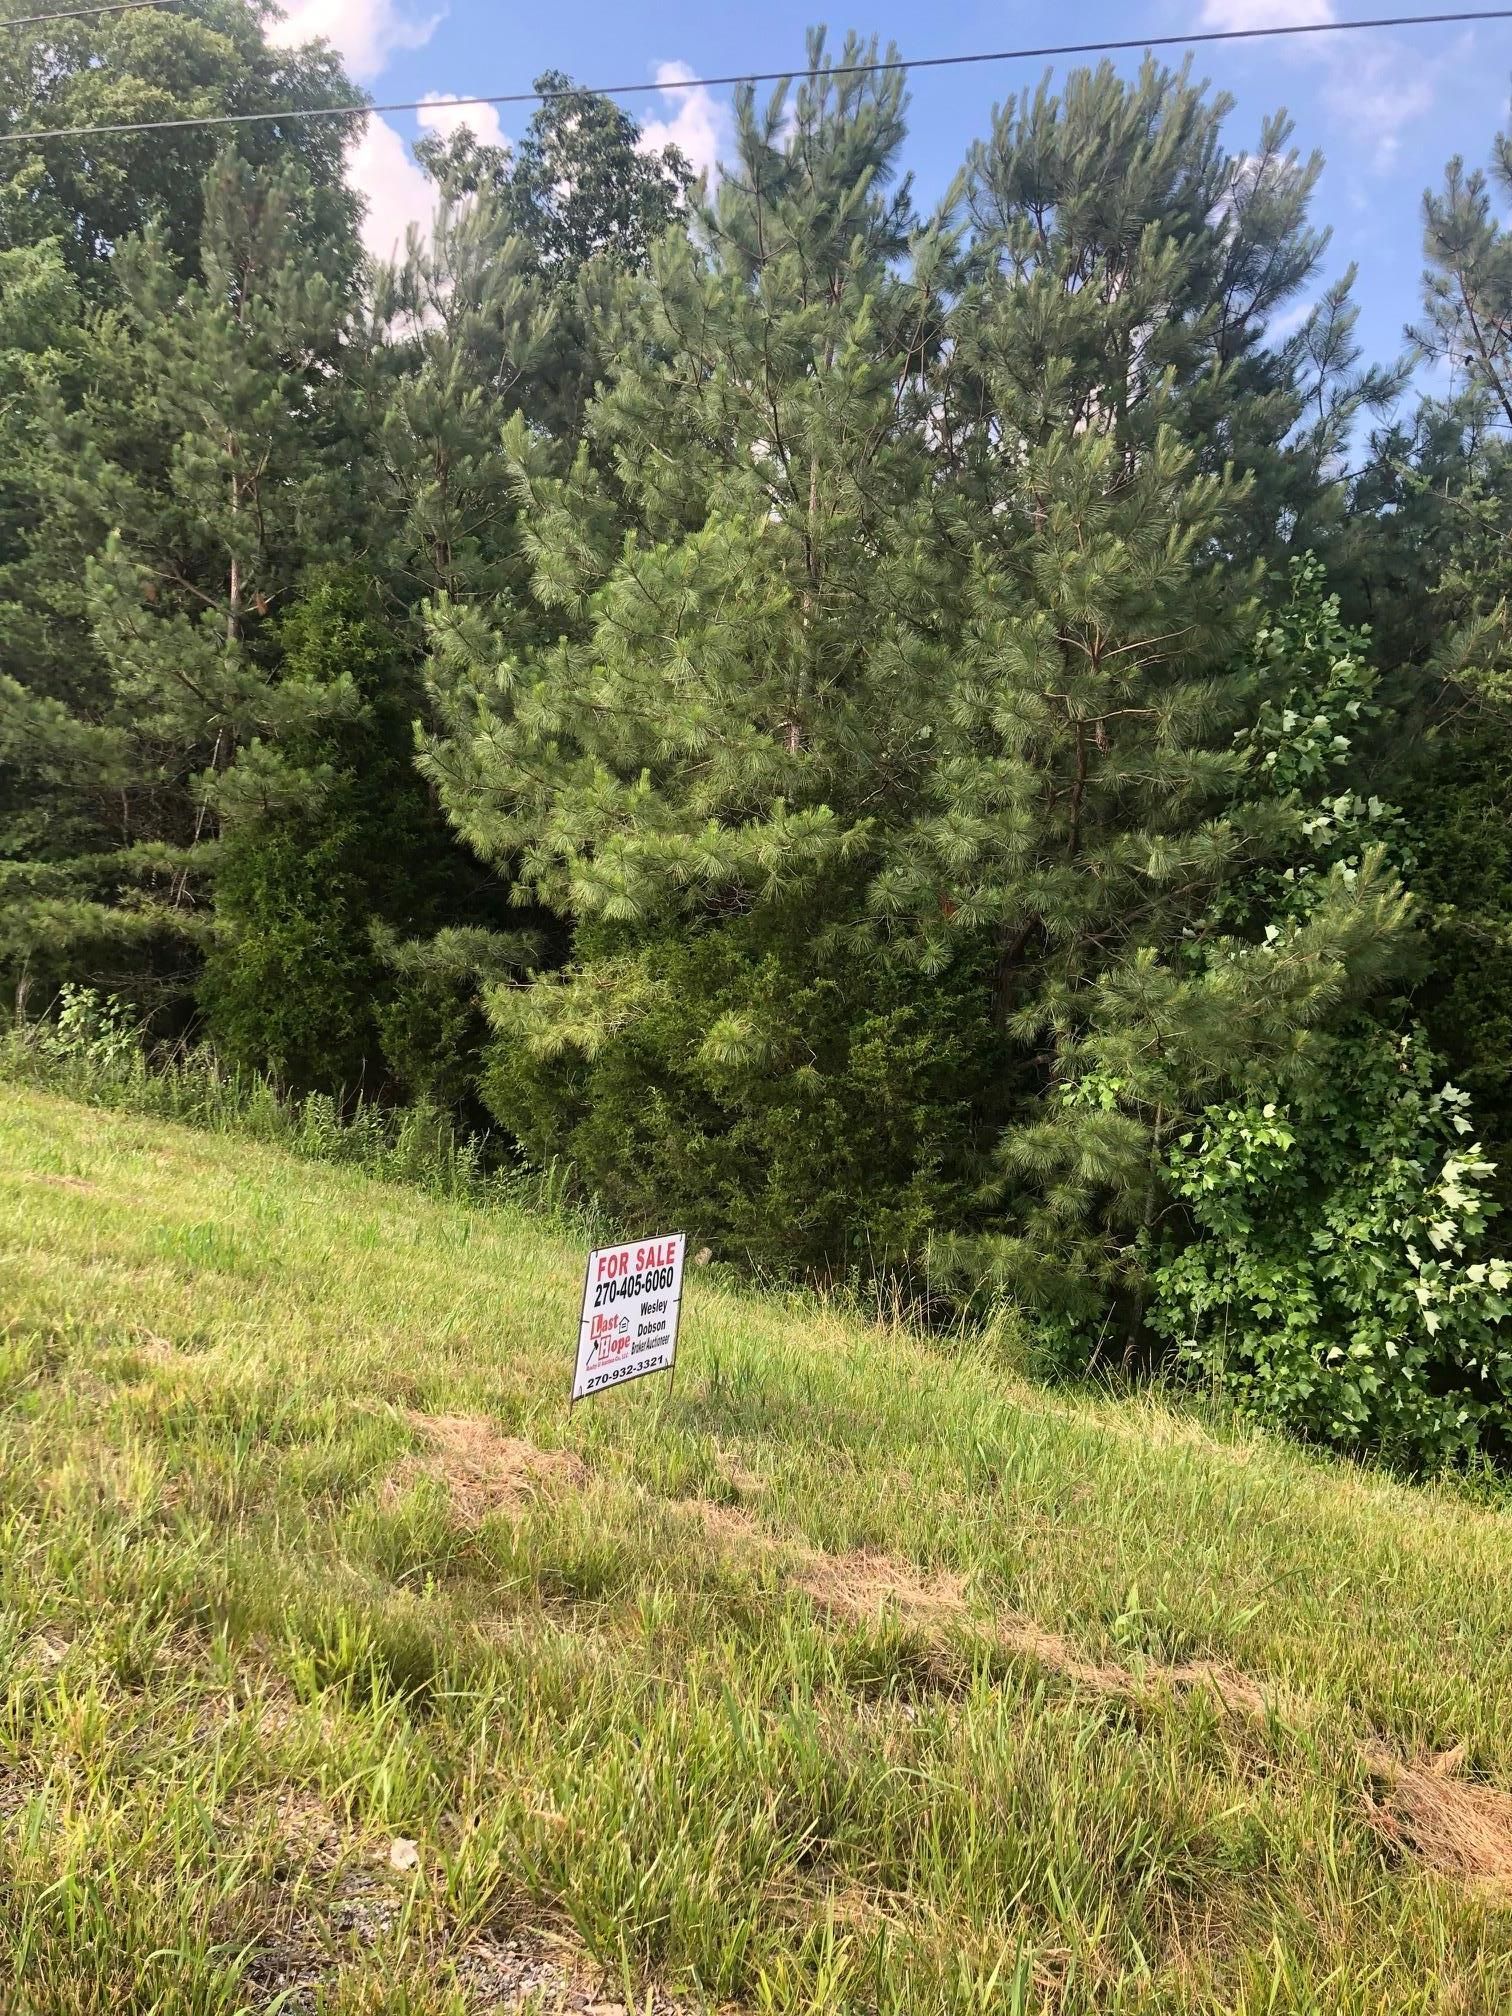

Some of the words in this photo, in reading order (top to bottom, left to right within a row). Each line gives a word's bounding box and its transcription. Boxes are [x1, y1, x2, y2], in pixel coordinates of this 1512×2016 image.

[597, 1252, 629, 1281] FOR
[636, 1242, 676, 1272] SALE
[594, 1266, 674, 1307] 270-405-6060
[640, 1299, 667, 1316] Wesley
[590, 1313, 619, 1340] Last
[637, 1320, 666, 1337] Dobson
[598, 1335, 631, 1361] Hope
[646, 1334, 670, 1351] Auctioneer
[586, 1355, 663, 1389] 270-932-3321
